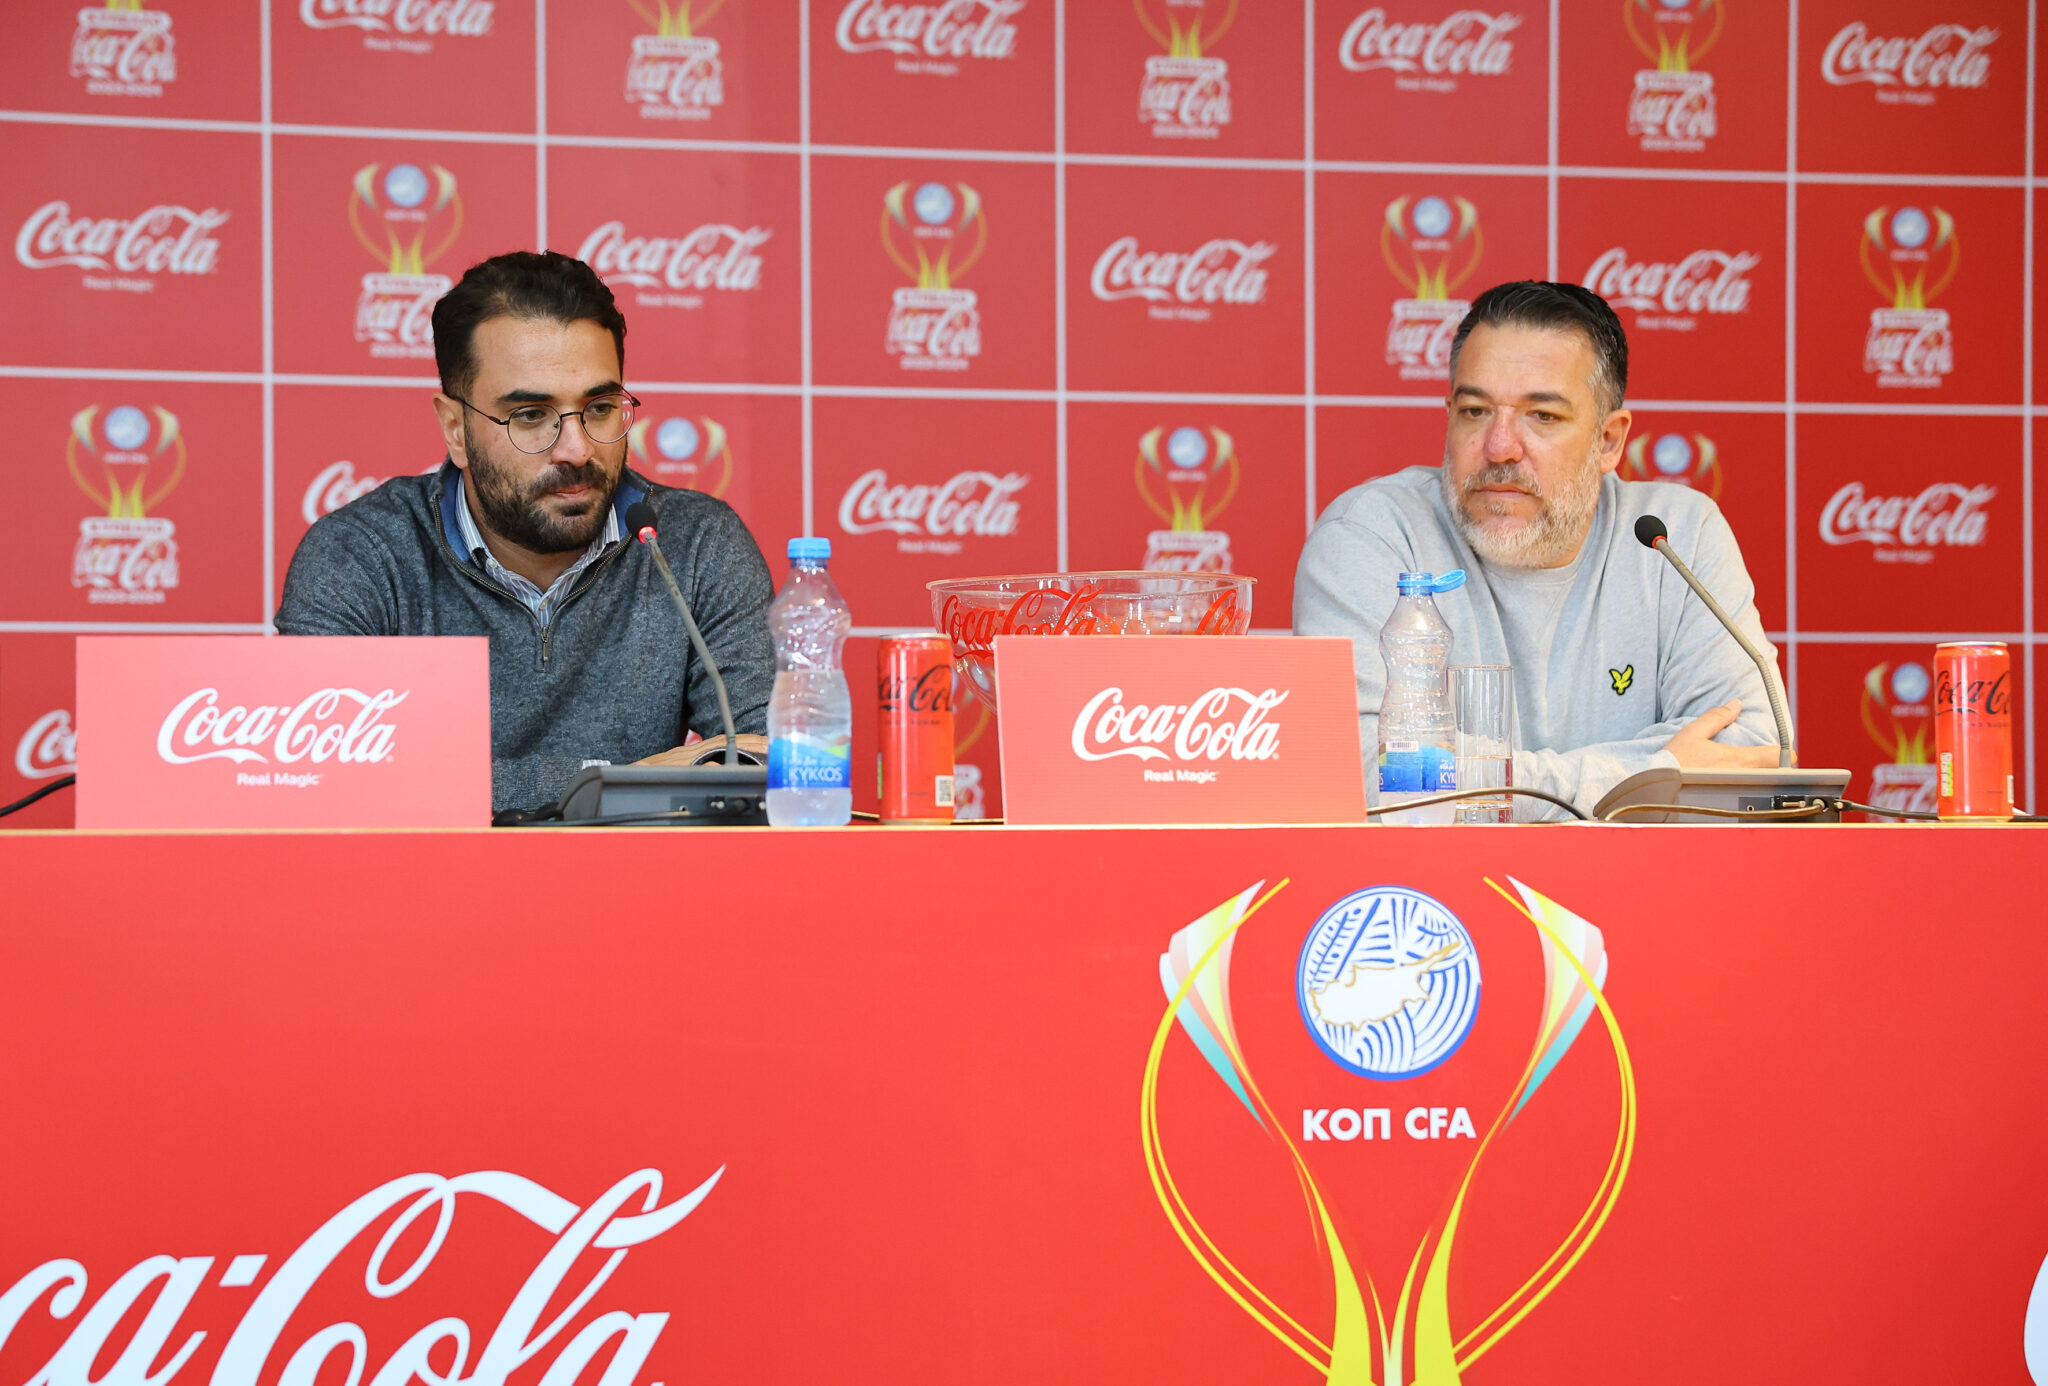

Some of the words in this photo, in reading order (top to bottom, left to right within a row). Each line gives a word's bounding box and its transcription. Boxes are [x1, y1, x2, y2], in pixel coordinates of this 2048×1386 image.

[836, 0, 1023, 58] Coca-Cola
[1339, 8, 1520, 74] Coca-Cola
[1821, 23, 1995, 87] Coca-Cola
[16, 201, 228, 274] Coca-Cola
[577, 220, 773, 291] Coca-Cola
[1091, 237, 1274, 303] Coca-Cola
[839, 470, 1027, 535] Coca-Cola
[1819, 483, 1994, 545] Coca-Cola
[157, 688, 409, 764] Coca-Cola
[1072, 687, 1289, 761] Coca-Cola
[237, 773, 271, 786] Real
[275, 773, 320, 788] Magic
[1144, 770, 1174, 782] Real
[1177, 770, 1216, 784] Magic
[1405, 1107, 1476, 1139] CFA
